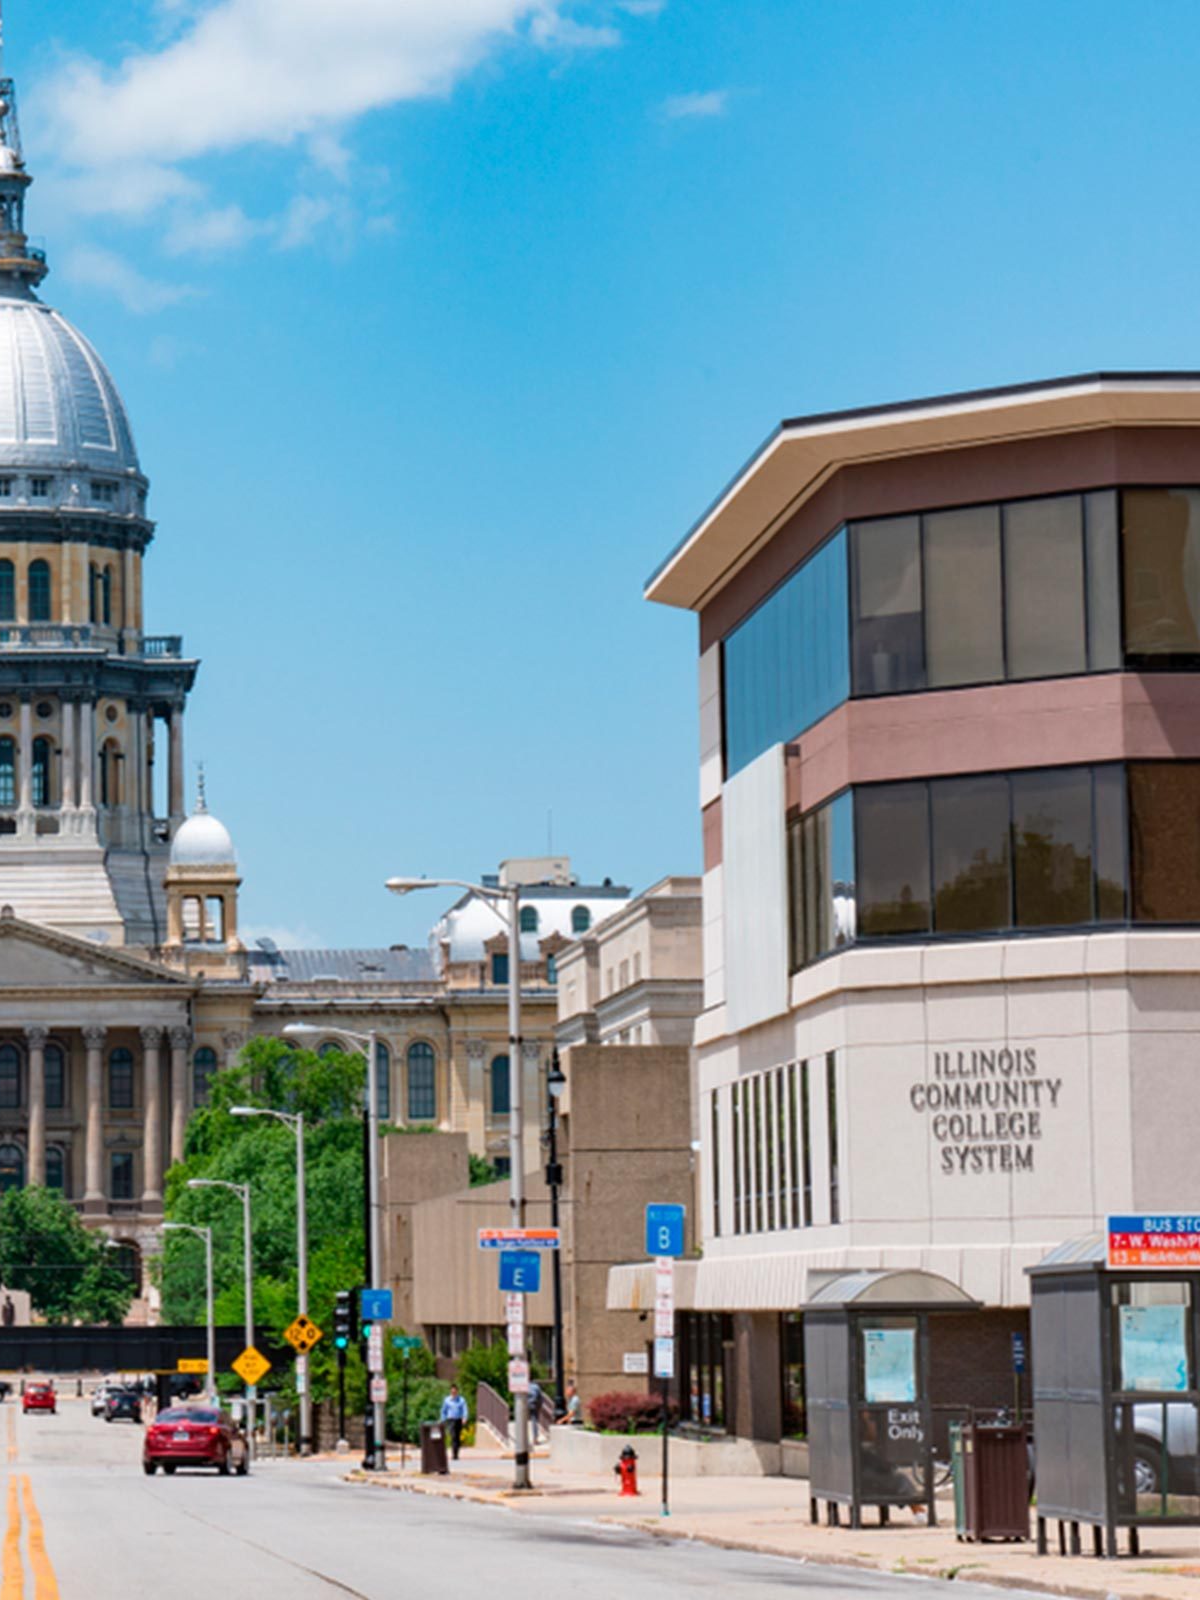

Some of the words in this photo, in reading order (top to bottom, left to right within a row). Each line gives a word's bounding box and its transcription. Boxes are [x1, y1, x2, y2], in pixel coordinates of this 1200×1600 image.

[934, 1047, 1038, 1080] ILLINOIS
[909, 1078, 1063, 1113] COMMUNITY
[932, 1111, 1042, 1142] COLLEGE
[940, 1144, 1035, 1175] SYSTEM
[1142, 1218, 1172, 1233] BUS
[513, 1268, 526, 1287] E
[888, 1408, 920, 1424] Exit
[888, 1425, 924, 1442] Only
